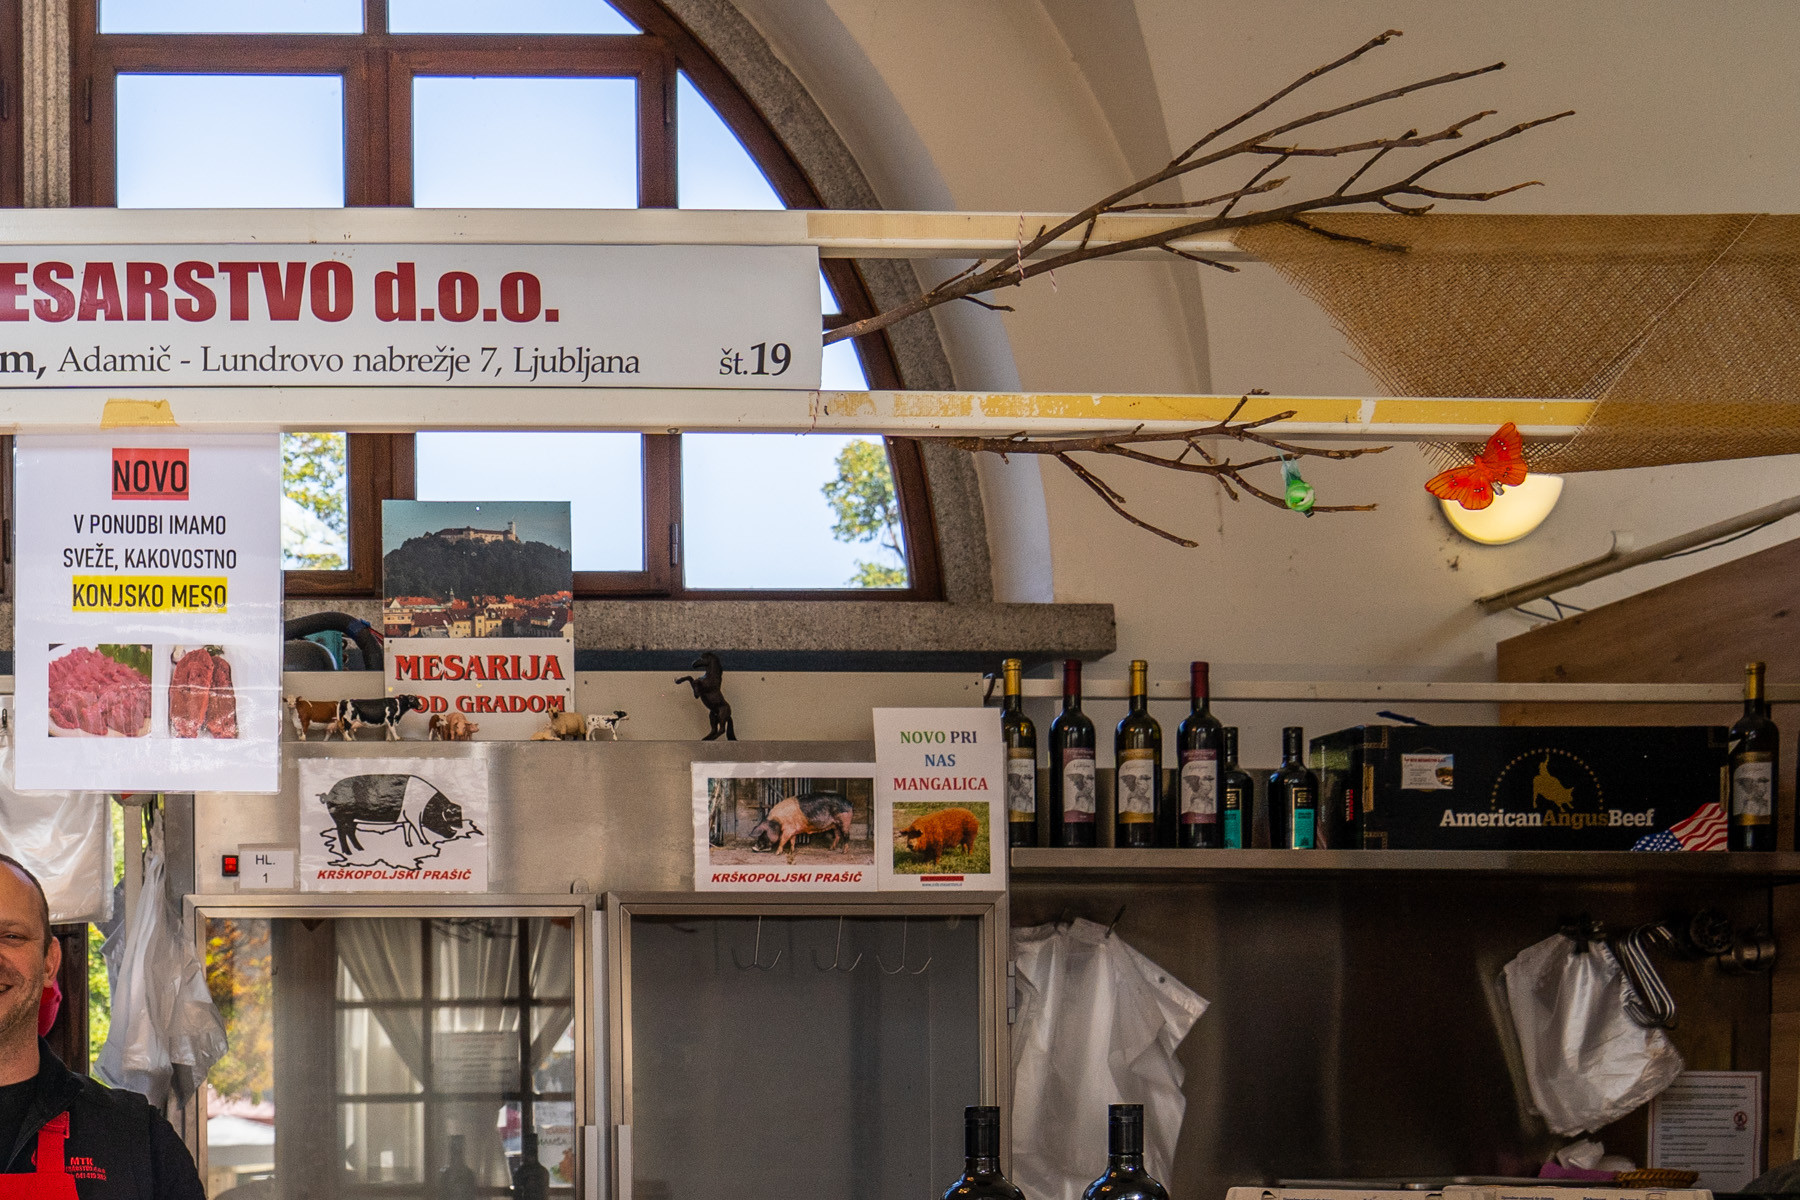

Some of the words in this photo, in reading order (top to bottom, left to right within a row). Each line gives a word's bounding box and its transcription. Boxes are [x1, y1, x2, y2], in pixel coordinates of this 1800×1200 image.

[374, 261, 560, 323] d.o.o.
[58, 344, 172, 373] Adamič
[201, 344, 345, 374] Lundrovo
[353, 344, 471, 381] nabrežje
[480, 348, 503, 378] 7,
[513, 344, 641, 382] Ljubljana
[112, 458, 188, 494] NOVO
[73, 515, 85, 535] V
[89, 514, 164, 536] PONUDBI
[169, 514, 227, 536] IMAMO
[62, 543, 119, 573] SVEŽE,
[124, 547, 237, 571] KAKOVOSTNO
[72, 583, 164, 610] KONJSKO
[171, 582, 229, 610] MESO
[394, 653, 566, 682] MESARIJA
[406, 694, 448, 715] OD
[455, 694, 566, 715] GRADOM
[900, 730, 946, 745] NOVO
[950, 730, 977, 745] PRI
[924, 753, 957, 767] NAS
[893, 776, 988, 791] MANGALICA
[255, 854, 276, 866] HL.
[262, 873, 269, 884] 1
[316, 866, 419, 881] KRŠKOPOLJSKI
[423, 865, 473, 881] PRAŠIČ
[711, 869, 812, 883] KRŠKOPOLJSKI
[814, 869, 863, 883] PRAŠIČ
[70, 1156, 93, 1166] MTK
